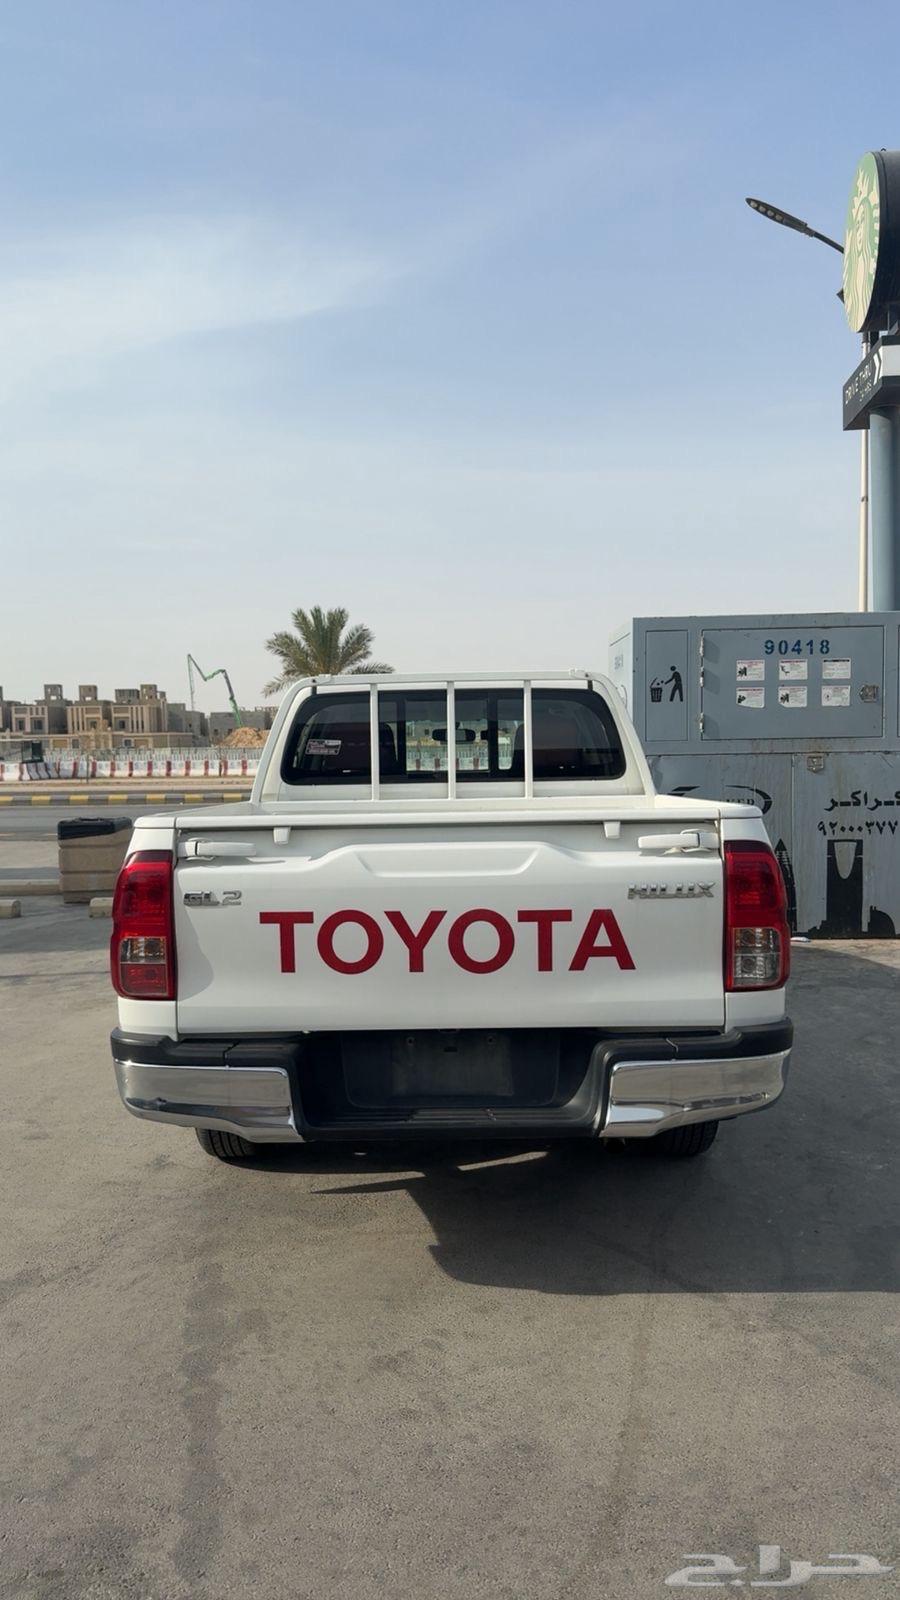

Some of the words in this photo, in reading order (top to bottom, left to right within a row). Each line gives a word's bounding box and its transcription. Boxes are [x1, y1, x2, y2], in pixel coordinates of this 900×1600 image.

[764, 639, 830, 655] 90418
[627, 882, 716, 900] HILUX
[259, 908, 636, 975] TOYOTA
